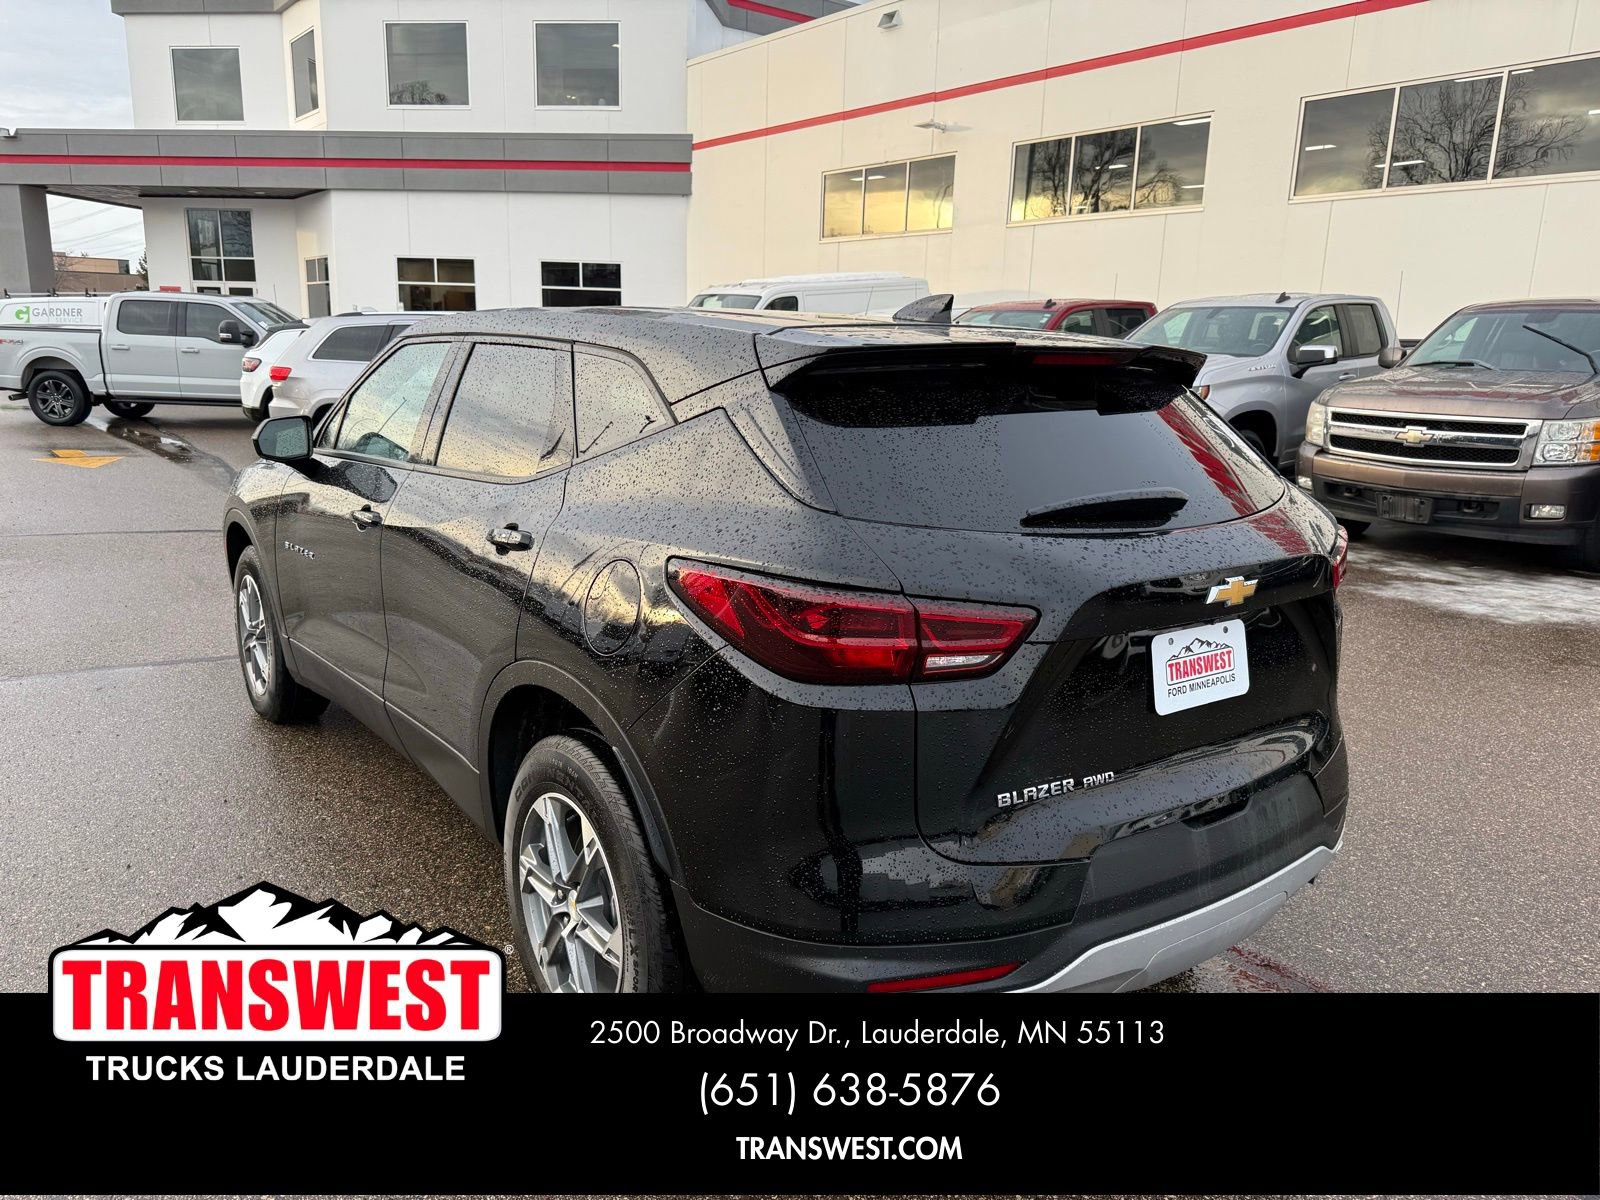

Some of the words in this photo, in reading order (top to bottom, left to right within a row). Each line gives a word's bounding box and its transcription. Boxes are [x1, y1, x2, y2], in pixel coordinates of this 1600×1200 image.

[32, 307, 83, 317] GARDNER
[1167, 650, 1232, 682] TRANSWEST
[1167, 685, 1187, 698] FORD
[1189, 673, 1236, 693] MINNEAPOLIS
[997, 778, 1075, 808] BLAZER
[1083, 771, 1115, 788] AWD
